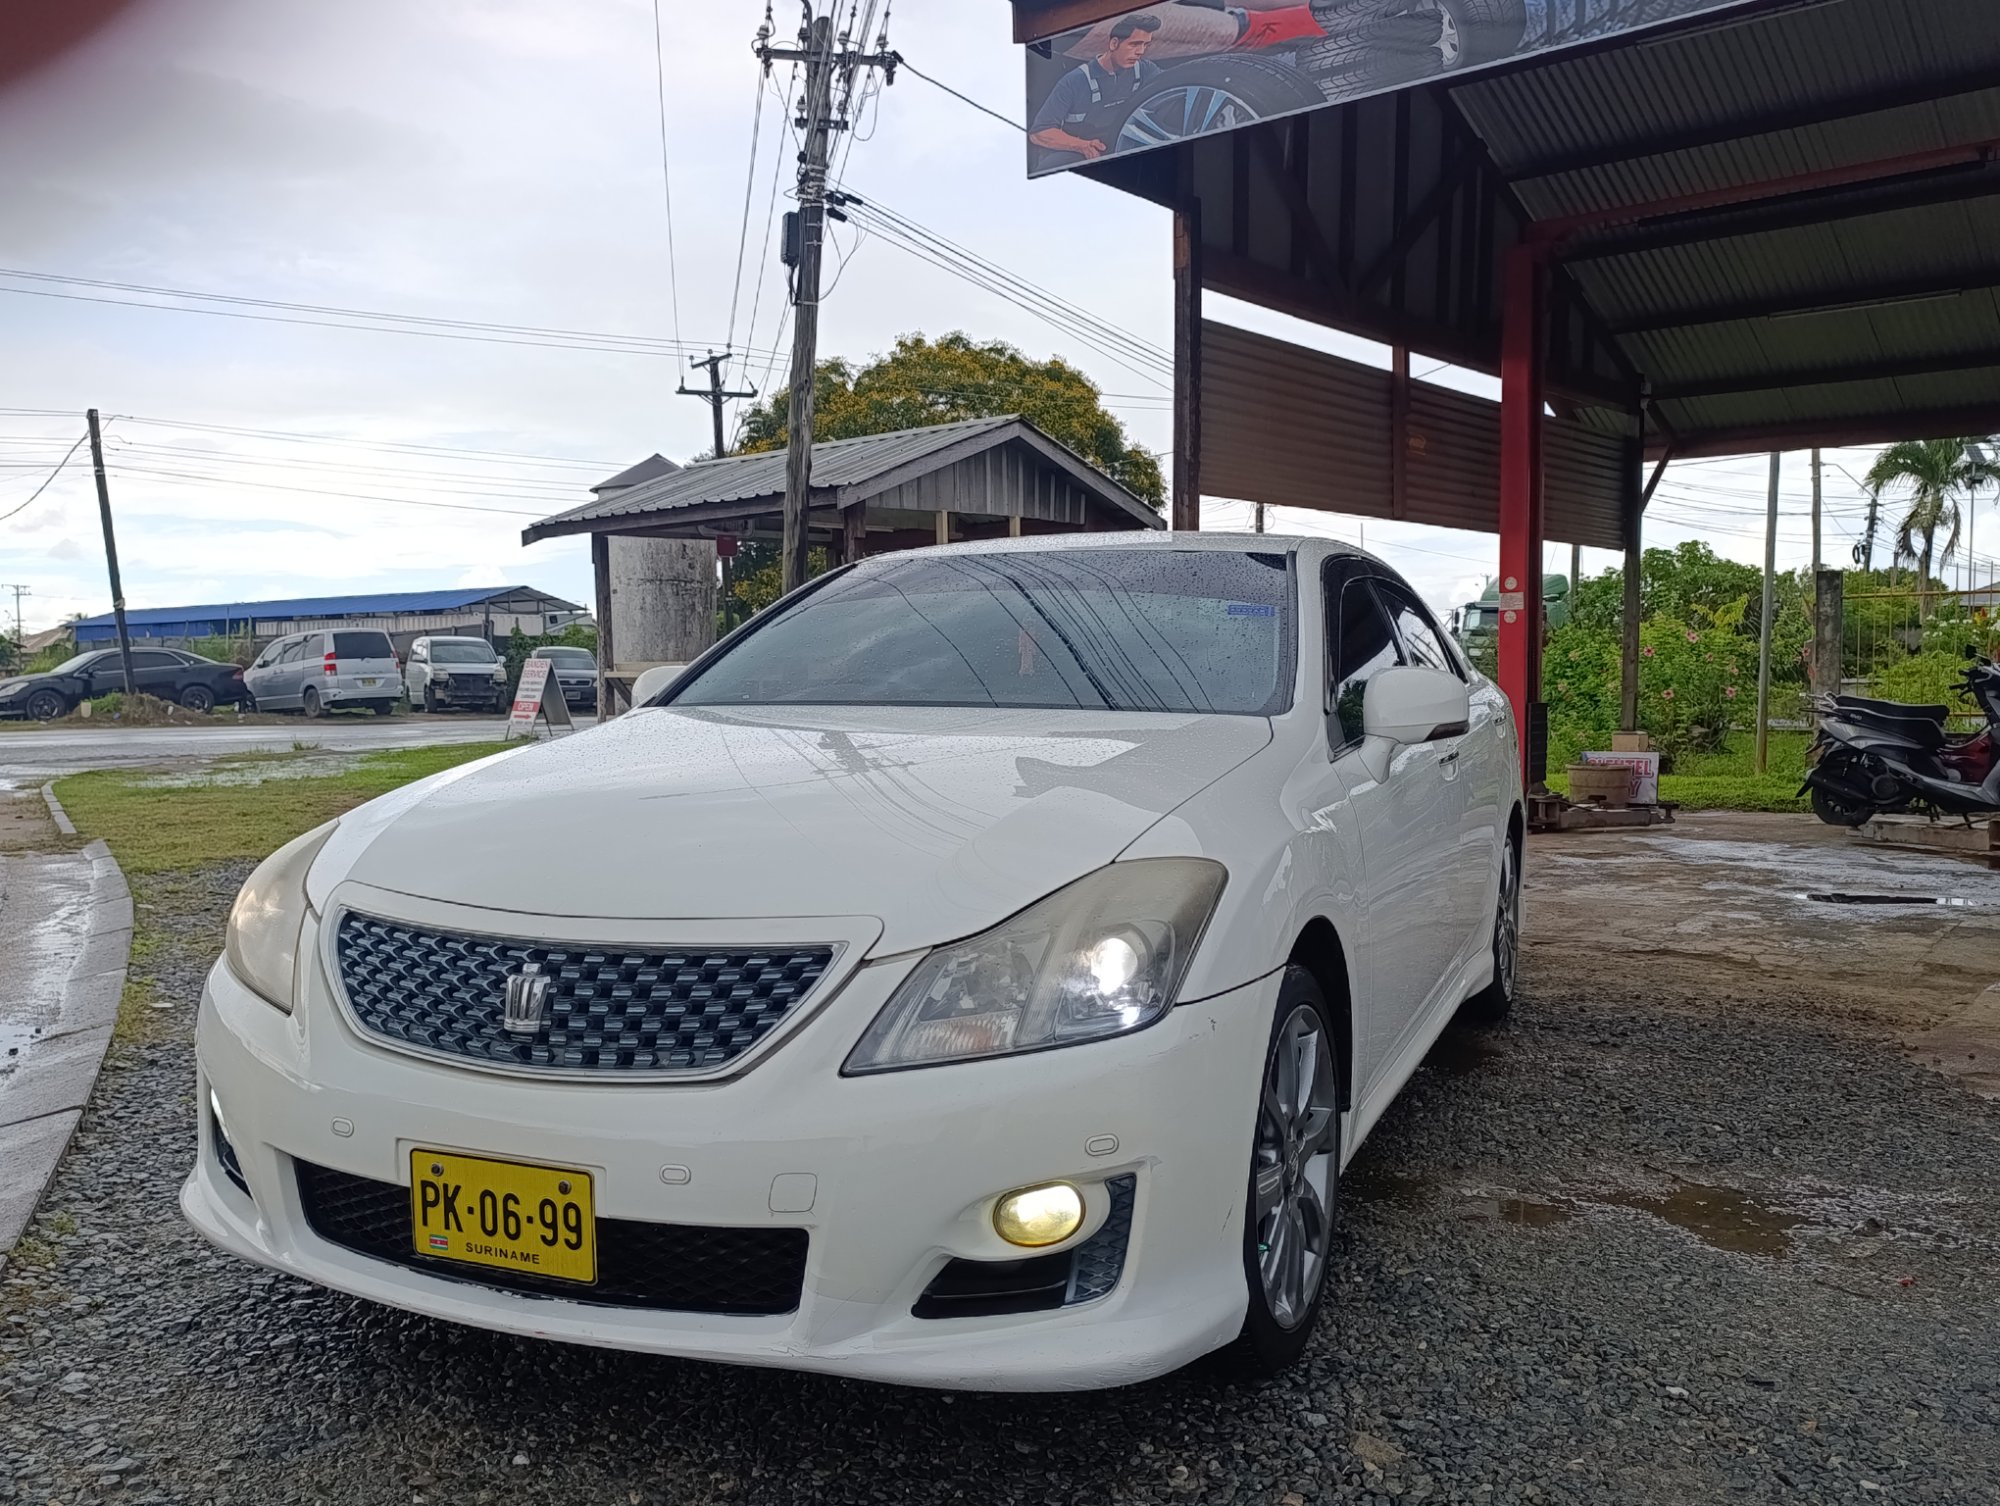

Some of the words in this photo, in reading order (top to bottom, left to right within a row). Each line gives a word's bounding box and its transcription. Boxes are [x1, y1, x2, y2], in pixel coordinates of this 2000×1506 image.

[523, 670, 547, 678] SERVICE
[517, 702, 533, 711] OPEN
[465, 1242, 541, 1265] SURINAME
